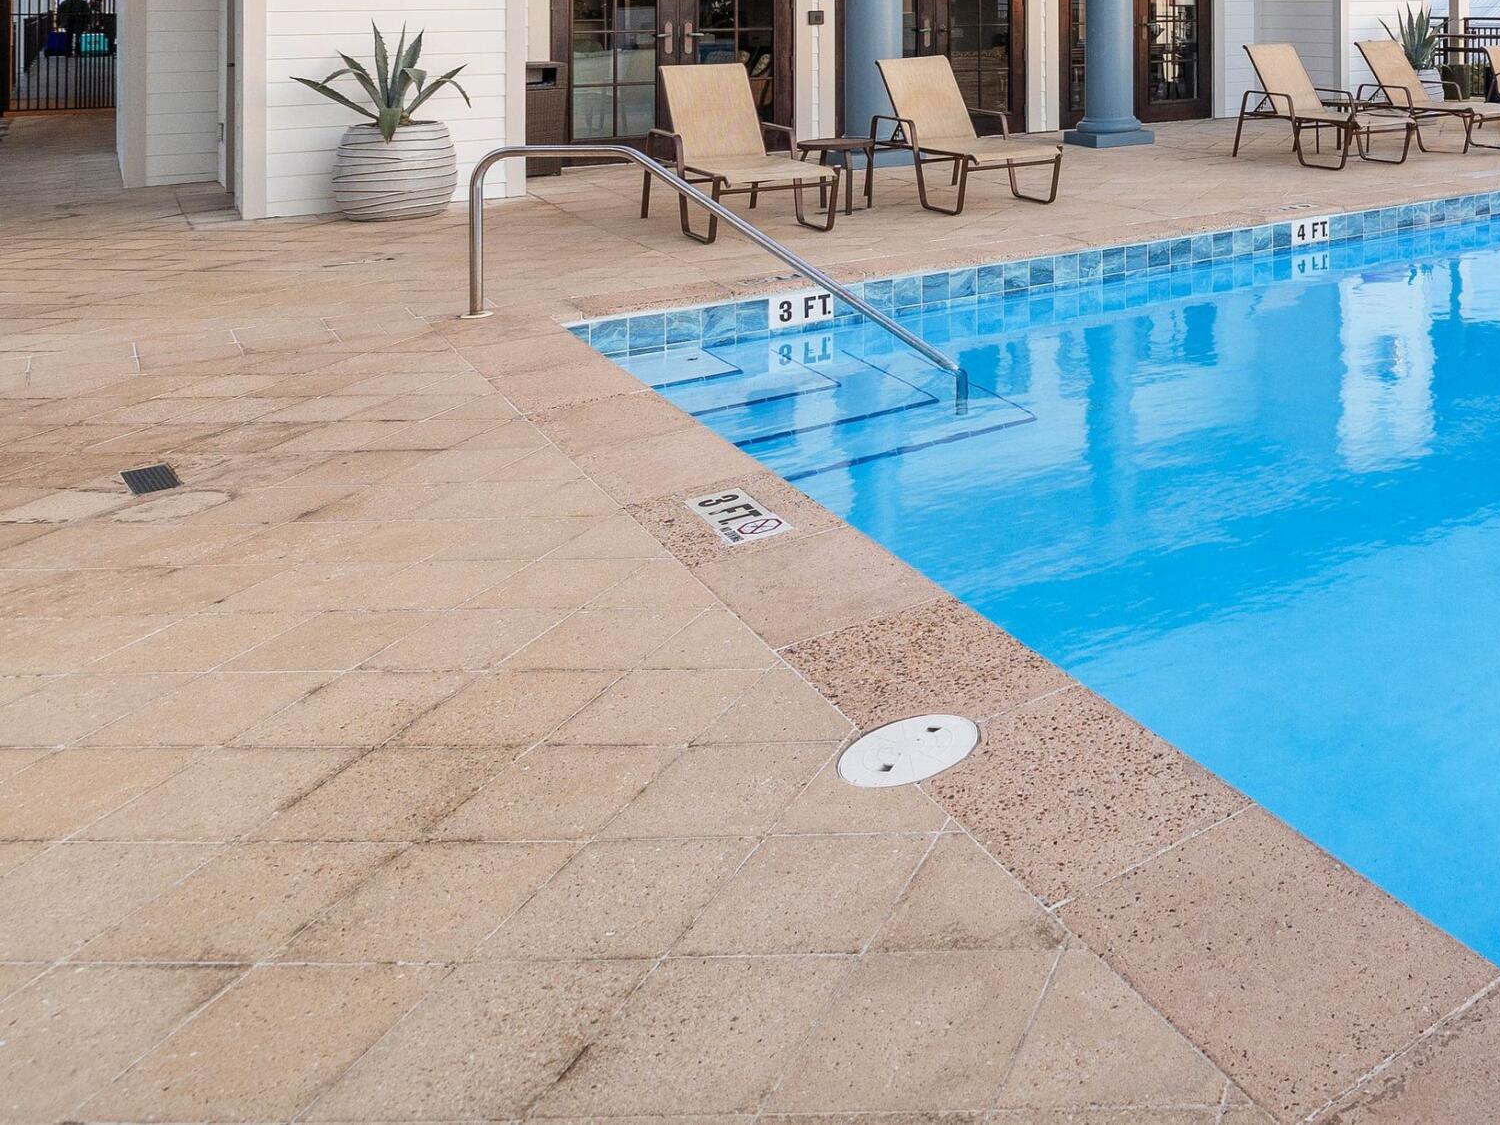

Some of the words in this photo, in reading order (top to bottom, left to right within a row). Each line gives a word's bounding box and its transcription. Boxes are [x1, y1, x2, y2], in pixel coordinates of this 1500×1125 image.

[1297, 224, 1306, 241] 4
[1311, 221, 1328, 239] FT.
[779, 300, 792, 323] 3
[803, 294, 832, 319] FT.
[698, 494, 740, 508] 3
[708, 503, 763, 526] FT.
